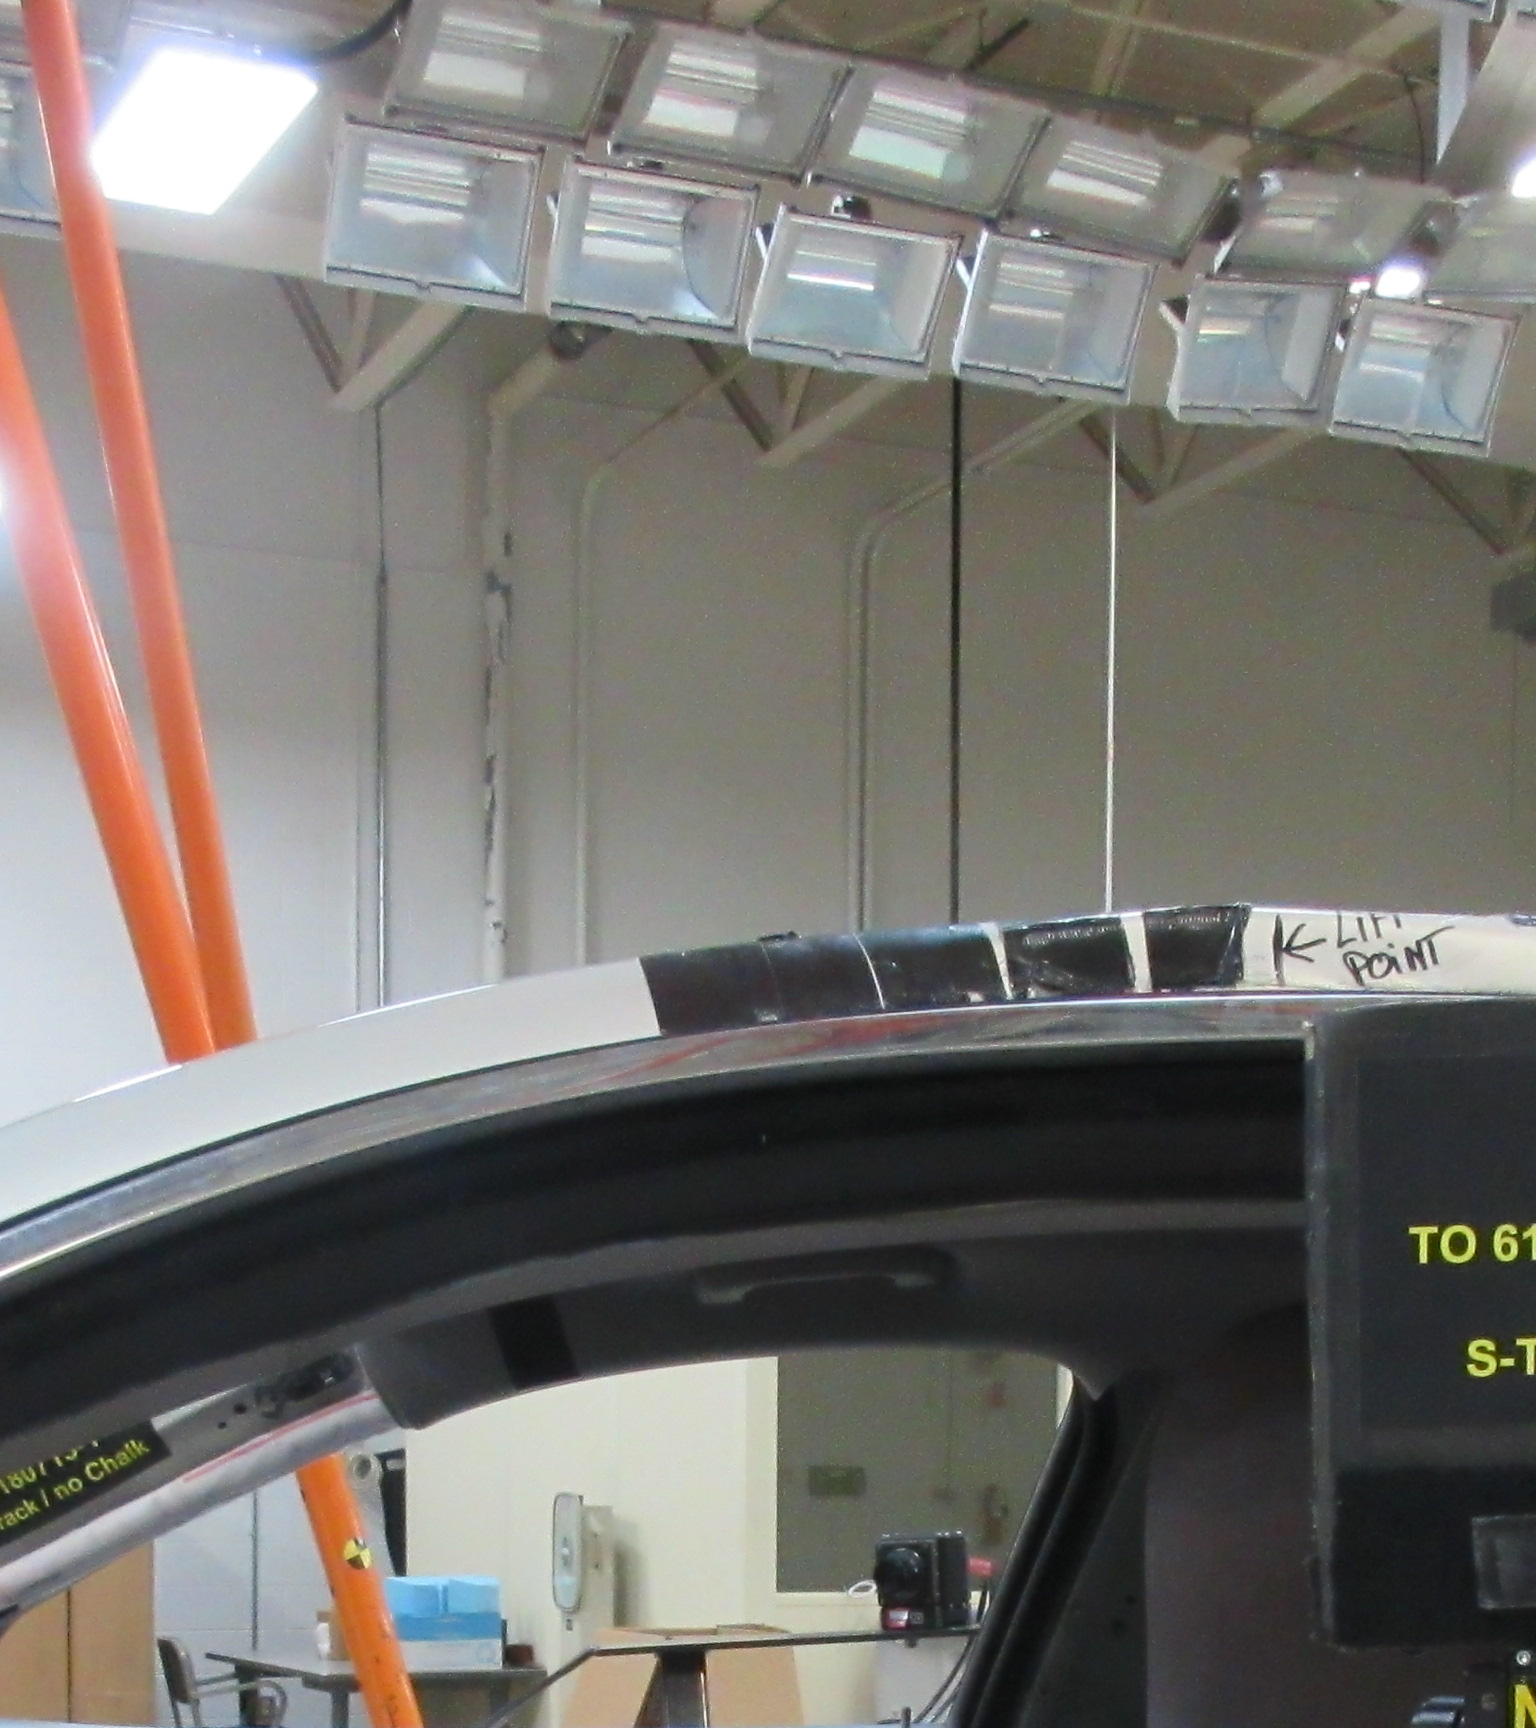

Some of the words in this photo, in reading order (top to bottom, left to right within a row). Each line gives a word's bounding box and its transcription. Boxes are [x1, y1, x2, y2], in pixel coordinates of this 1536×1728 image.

[1408, 1225, 1477, 1265] TO
[53, 1477, 84, 1501] no
[83, 1439, 151, 1483] Chalk
